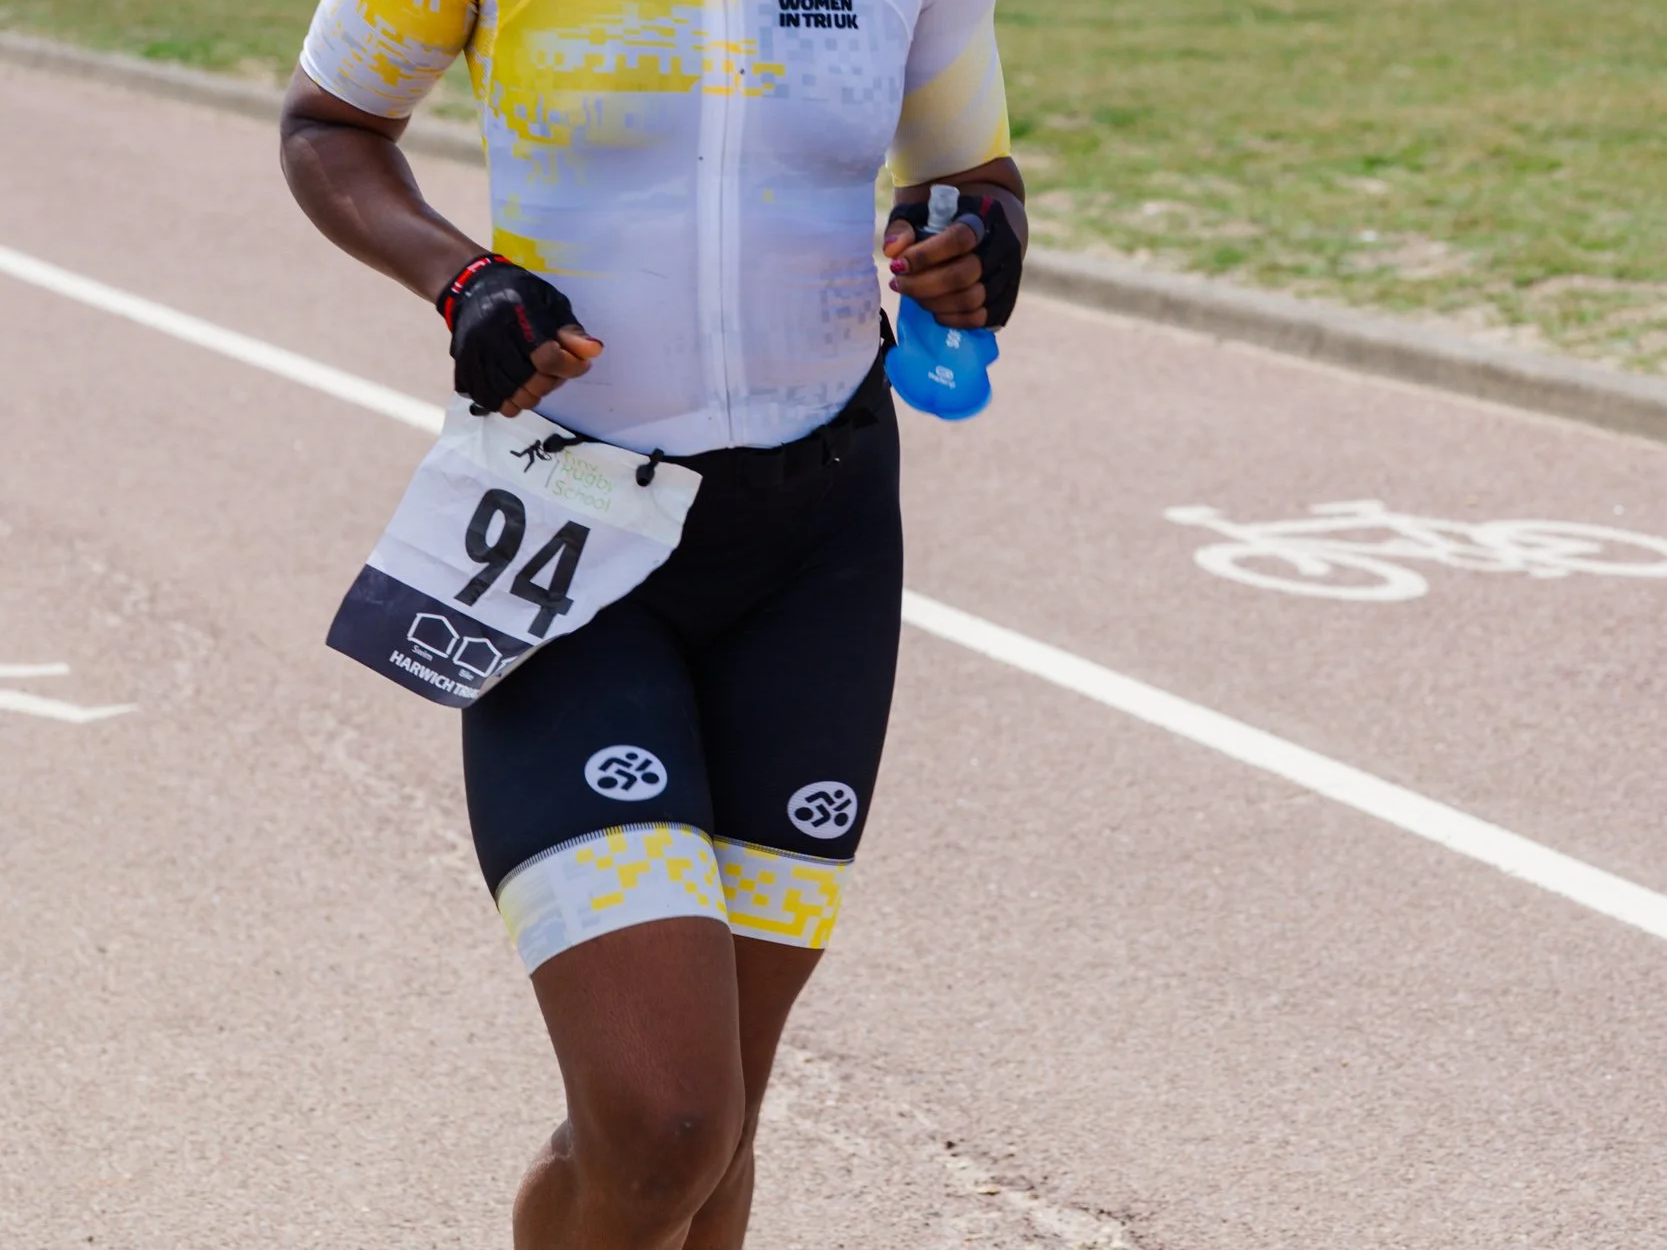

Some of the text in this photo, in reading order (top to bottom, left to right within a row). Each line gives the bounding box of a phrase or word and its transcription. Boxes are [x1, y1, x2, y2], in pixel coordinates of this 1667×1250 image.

[779, 13, 859, 30] IN TRI UK
[552, 480, 611, 513] School
[561, 464, 612, 496] Rugby
[454, 488, 590, 639] 94
[389, 650, 454, 692] HARWICH
